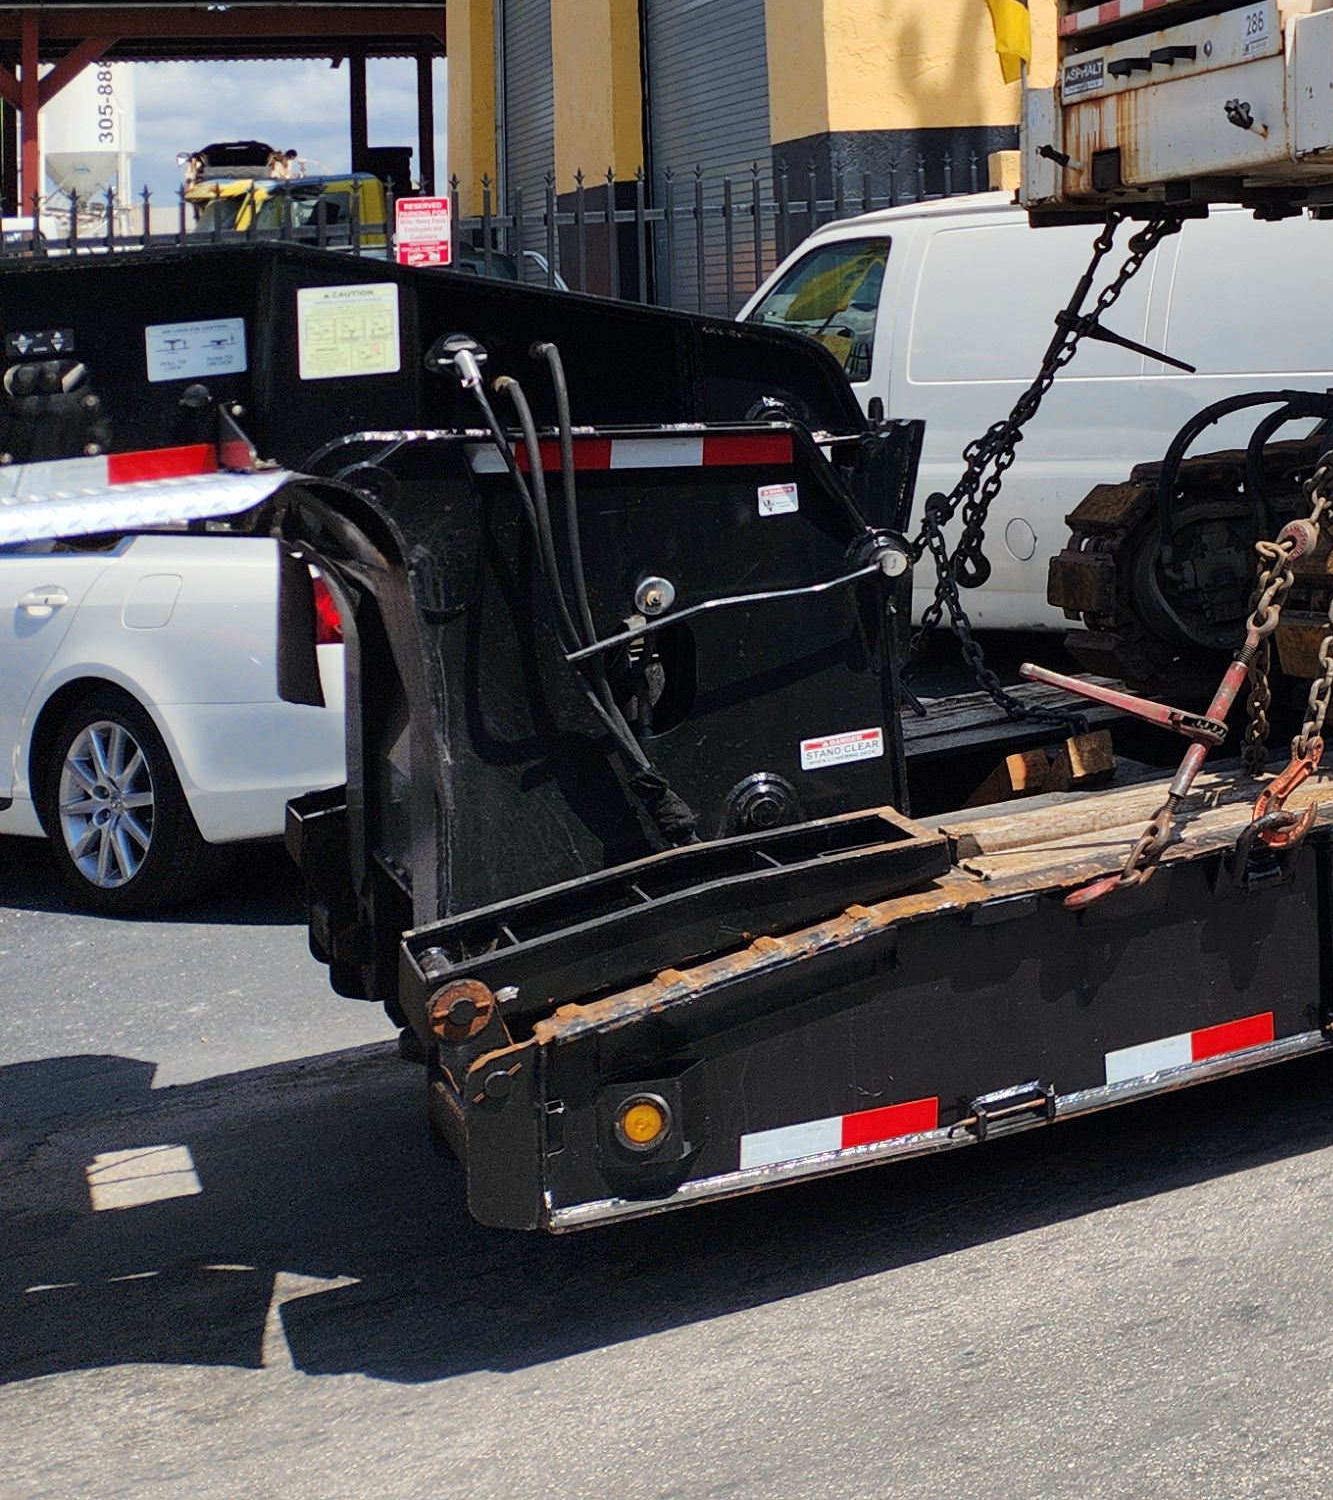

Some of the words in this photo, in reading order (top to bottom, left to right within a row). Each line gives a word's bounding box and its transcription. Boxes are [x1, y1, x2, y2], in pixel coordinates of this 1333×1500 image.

[1246, 10, 1264, 37] 286
[1065, 61, 1103, 83] ASPHALT
[403, 202, 442, 210] RESERVED
[431, 209, 447, 217] FOR
[331, 289, 374, 299] CAUTION
[829, 734, 863, 746] DANGER
[806, 746, 842, 762] STAND
[843, 740, 880, 754] CLEAR
[860, 749, 877, 757] DECK
